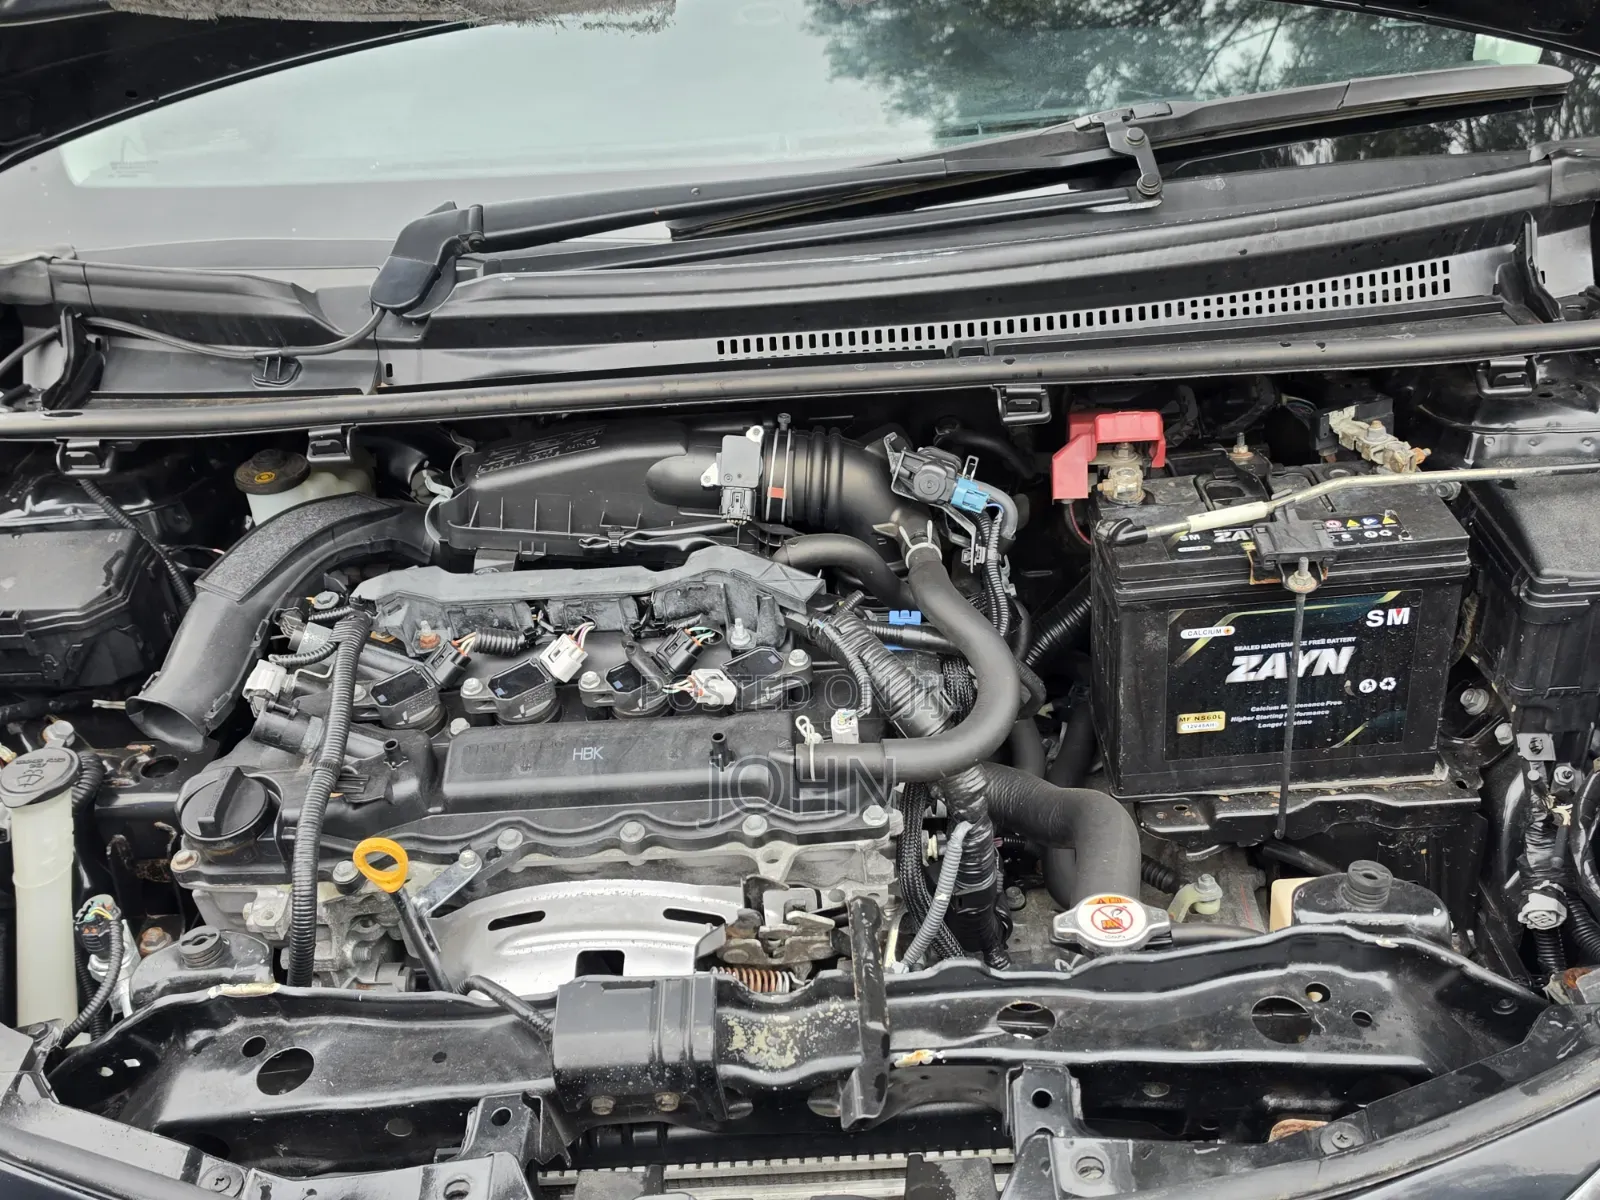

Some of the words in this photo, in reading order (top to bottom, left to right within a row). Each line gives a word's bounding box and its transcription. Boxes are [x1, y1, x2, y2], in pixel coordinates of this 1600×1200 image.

[1213, 529, 1254, 543] ZA
[1365, 607, 1410, 628] SM
[1187, 628, 1222, 637] CALCIUM
[1261, 641, 1308, 649] MAINTENACE
[1308, 638, 1326, 646] FREE
[1326, 636, 1357, 644] BATTERY
[1225, 646, 1355, 684] ZAYN
[1257, 721, 1283, 729] Longer
[572, 746, 604, 761] HBK
